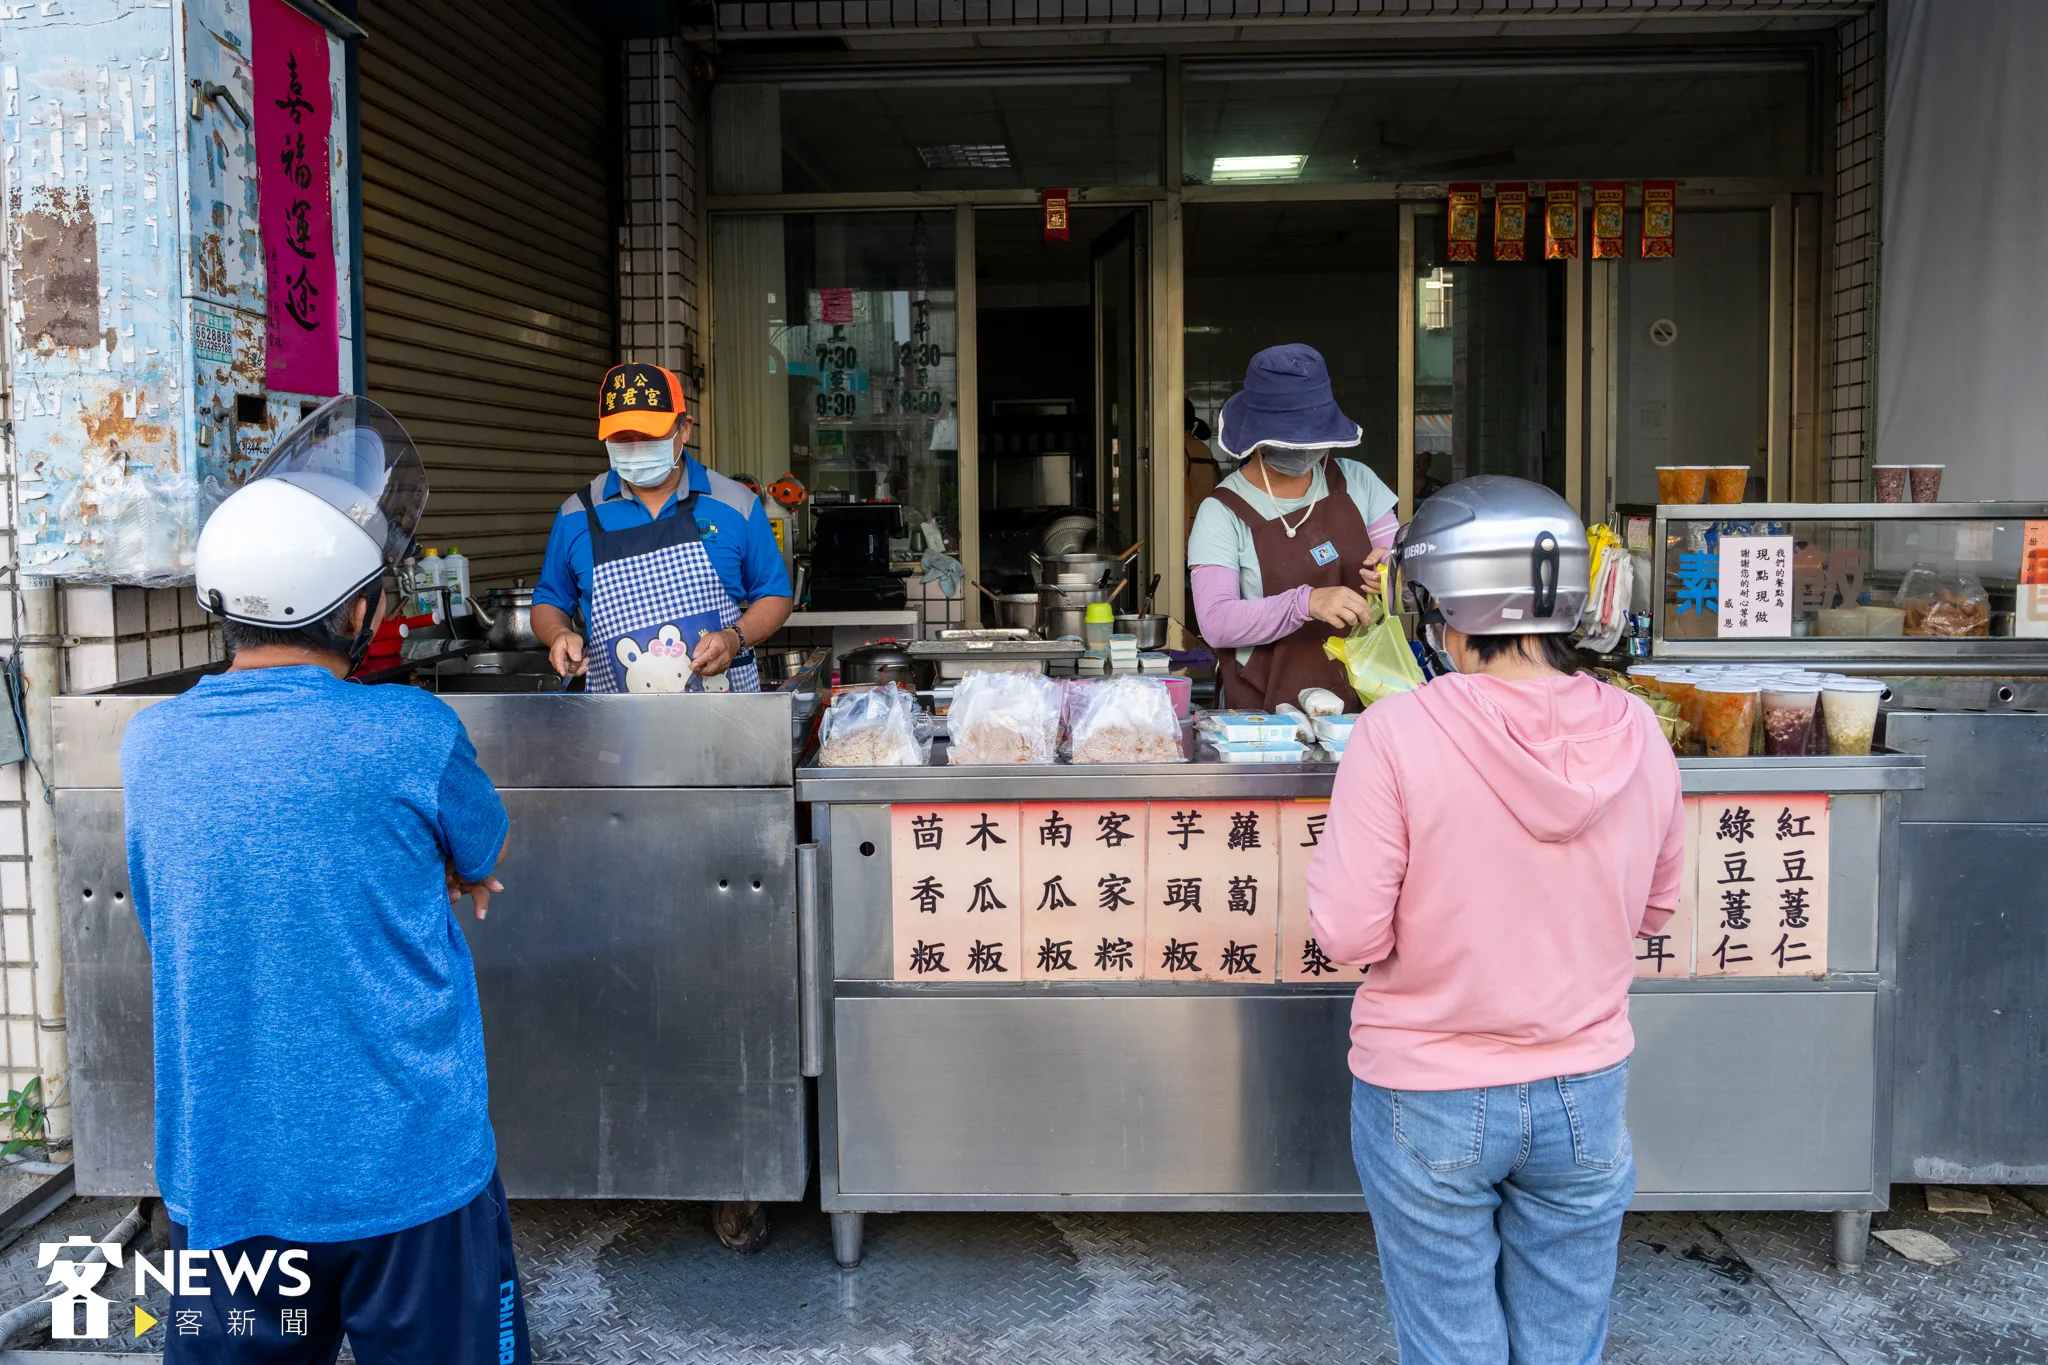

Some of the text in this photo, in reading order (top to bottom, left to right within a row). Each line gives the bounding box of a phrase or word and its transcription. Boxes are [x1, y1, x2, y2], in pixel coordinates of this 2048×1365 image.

[196, 326, 232, 344] 6628888
[816, 344, 857, 371] 7:30
[900, 344, 941, 367] 2:30
[605, 387, 661, 411] 聖君宮
[816, 393, 856, 416] 9:30
[1677, 550, 1719, 616] 素
[1724, 599, 1734, 628] 感恩
[1739, 549, 1750, 627] 謝謝您的耐心等候
[1755, 548, 1770, 623] 現點現做
[1775, 548, 1785, 607] 我們的餐點為
[910, 812, 950, 974] 茴香粄
[966, 812, 1008, 974] 木瓜粄
[1036, 810, 1077, 972] 南瓜粄
[1094, 811, 1135, 971] 客家粽
[1161, 810, 1204, 973] 芋頭粄
[1220, 811, 1261, 975] 蘿蔔粄
[1712, 806, 1755, 969] 綠豆薏仁
[1771, 807, 1815, 968] 紅豆薏仁
